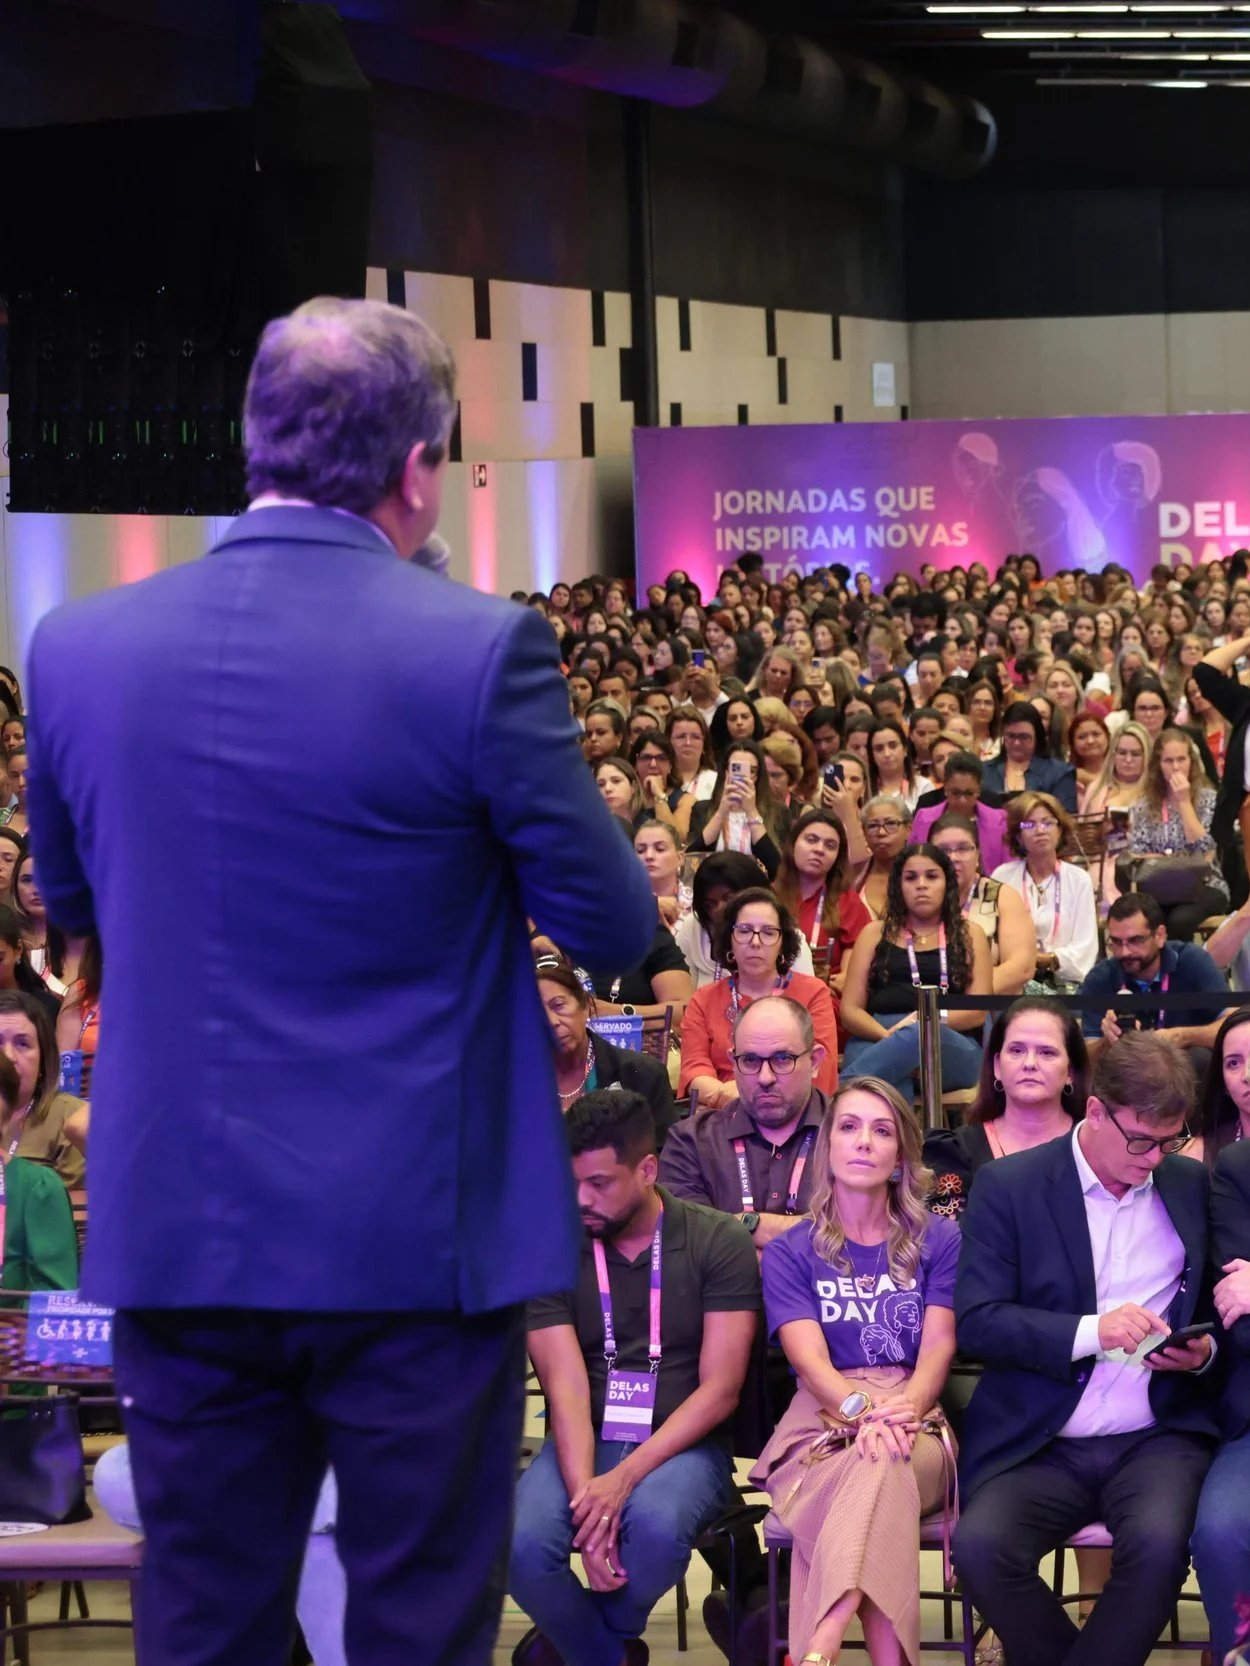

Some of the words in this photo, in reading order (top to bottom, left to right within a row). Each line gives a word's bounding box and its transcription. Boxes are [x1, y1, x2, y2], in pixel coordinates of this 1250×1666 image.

[713, 488, 867, 521] JORNADAS
[875, 486, 935, 518] QUE
[715, 524, 856, 552] INSPIRAM
[865, 522, 969, 548] NOVAS
[592, 1022, 632, 1031] SERVADO
[739, 1157, 748, 1179] DELAS
[741, 1180, 749, 1193] DAY
[652, 1245, 661, 1271] DELAS
[821, 1300, 879, 1323] DAY
[604, 1312, 612, 1339] DELAS
[609, 1390, 634, 1401] DAY
[610, 1380, 650, 1393] DELAS
